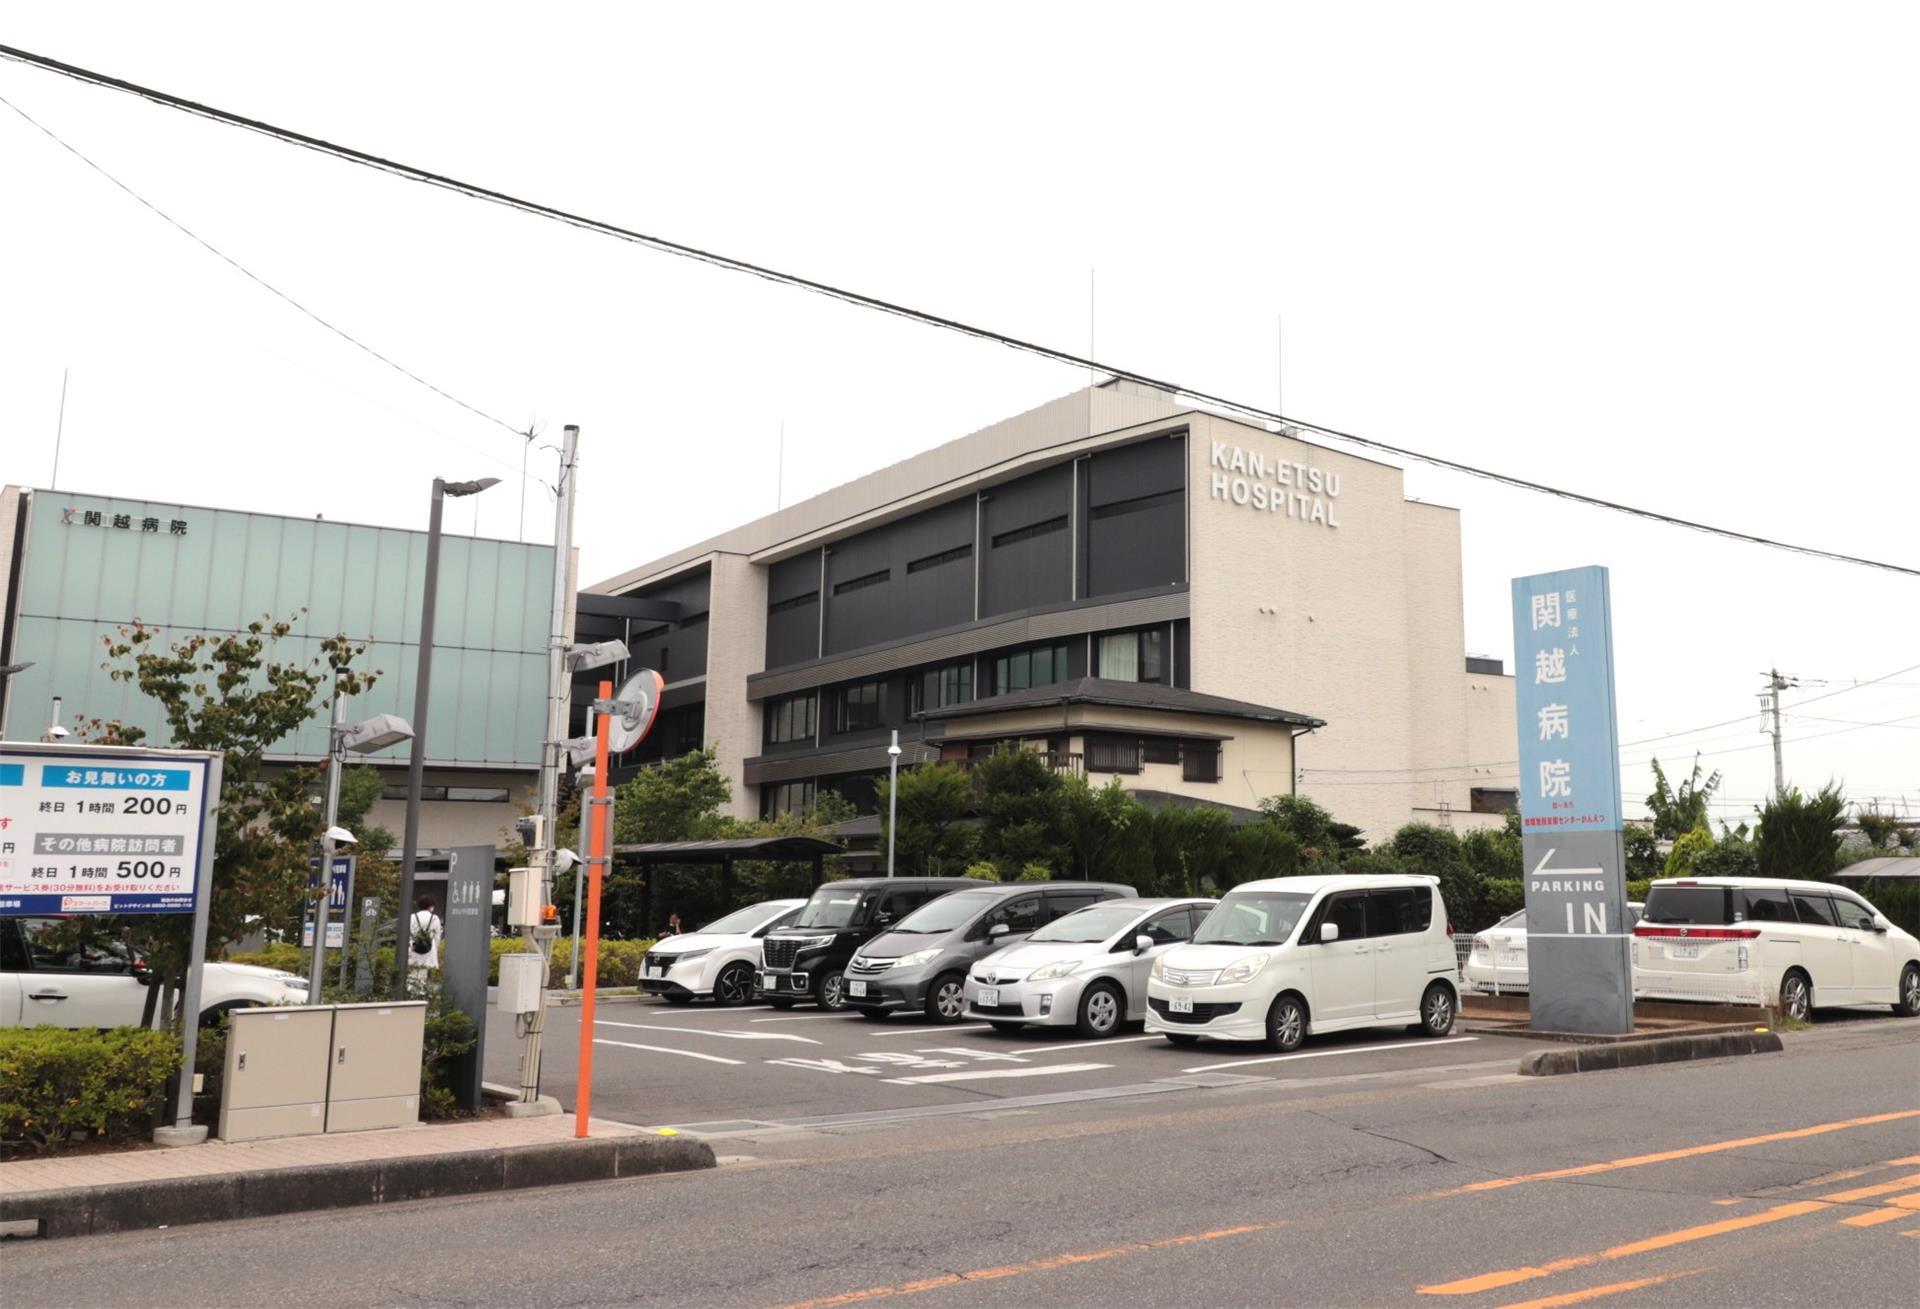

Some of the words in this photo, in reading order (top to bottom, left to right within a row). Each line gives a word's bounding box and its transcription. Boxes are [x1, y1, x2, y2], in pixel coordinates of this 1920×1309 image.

[1211, 440, 1341, 498] KAN-ETSU
[1211, 472, 1341, 529] HOSPITAL
[84, 510, 188, 535] 関越病院
[1565, 589, 1580, 656] 医療法人
[1530, 592, 1572, 798] 関越病院
[65, 770, 167, 787] お見舞いの方
[39, 801, 65, 813] 終日
[41, 837, 177, 854] その他病院訪問者
[31, 867, 57, 878] 終日
[1531, 881, 1605, 892] PARKING
[1566, 902, 1607, 934] IN
